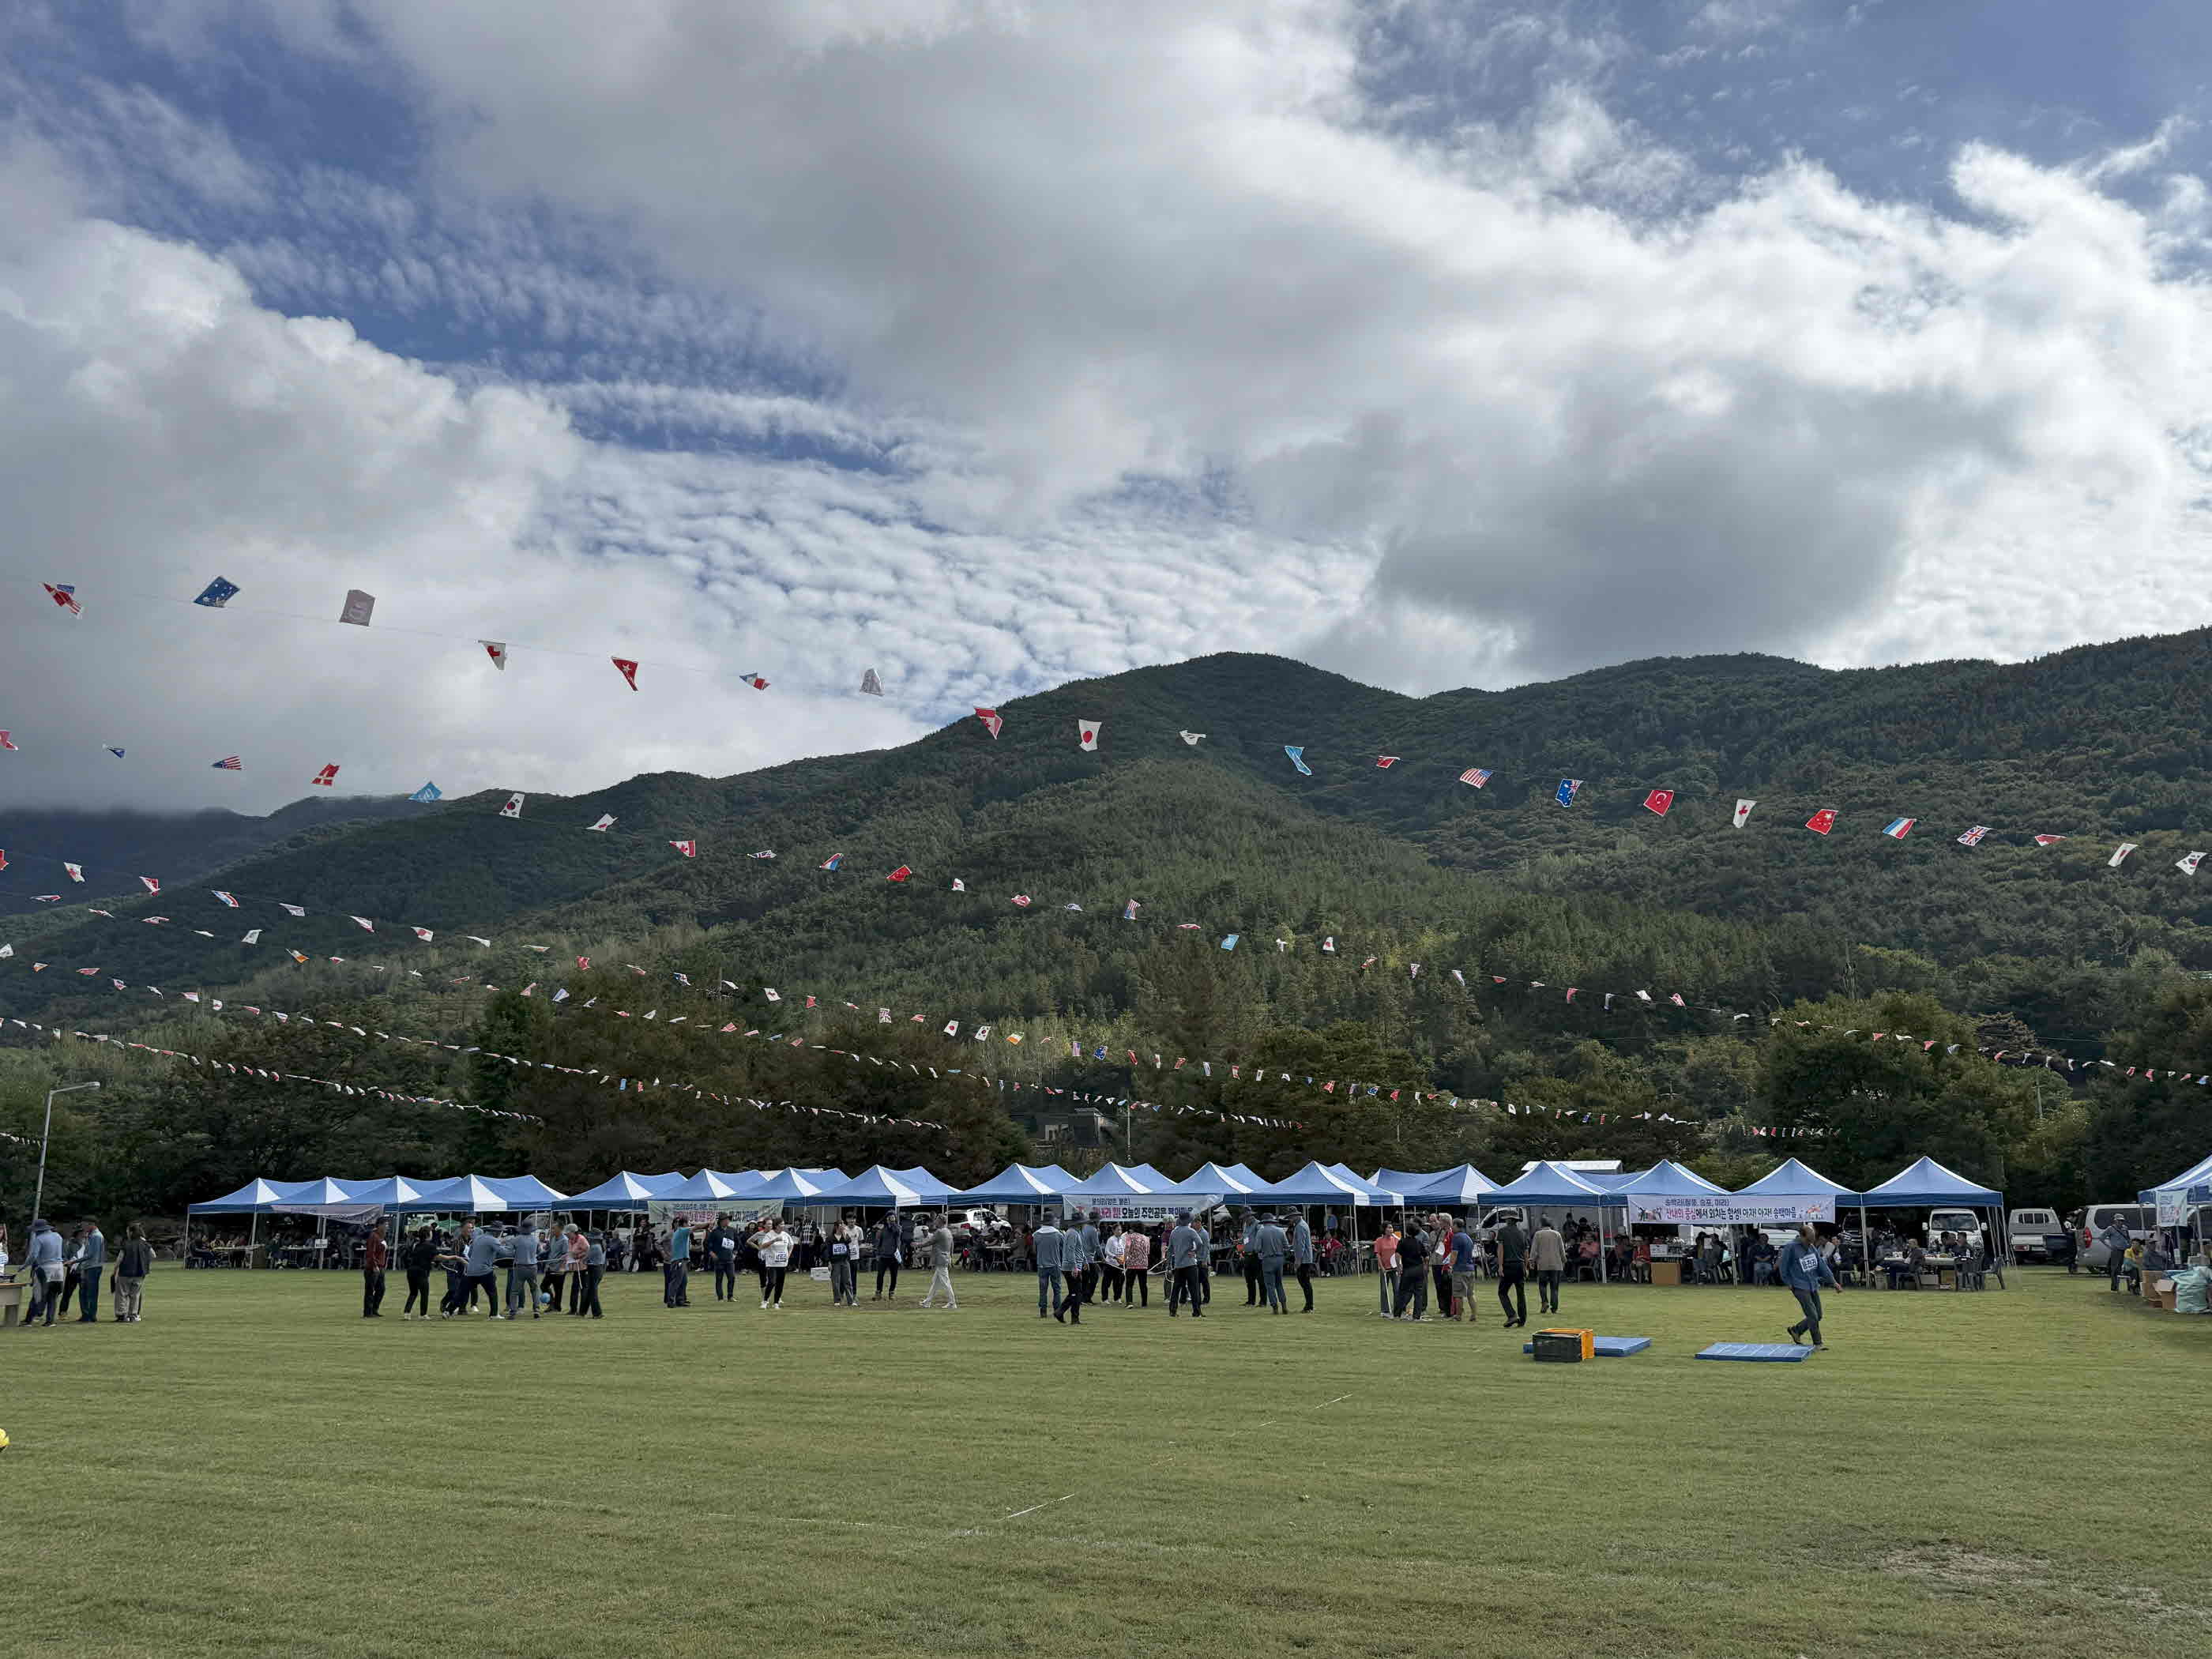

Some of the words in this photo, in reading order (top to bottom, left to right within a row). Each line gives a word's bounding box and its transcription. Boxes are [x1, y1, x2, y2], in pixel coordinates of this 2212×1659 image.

[1122, 1207, 1140, 1219] 오늘의
[1142, 1207, 1167, 1219] 주인공은
[1685, 1207, 1708, 1221] 중심에서
[1709, 1208, 1727, 1220] 외치는
[1727, 1208, 1742, 1221] 함성!
[1742, 1207, 1757, 1218] 아자!
[1758, 1207, 1773, 1218] 아자!
[1773, 1206, 1796, 1219] 송백마을
